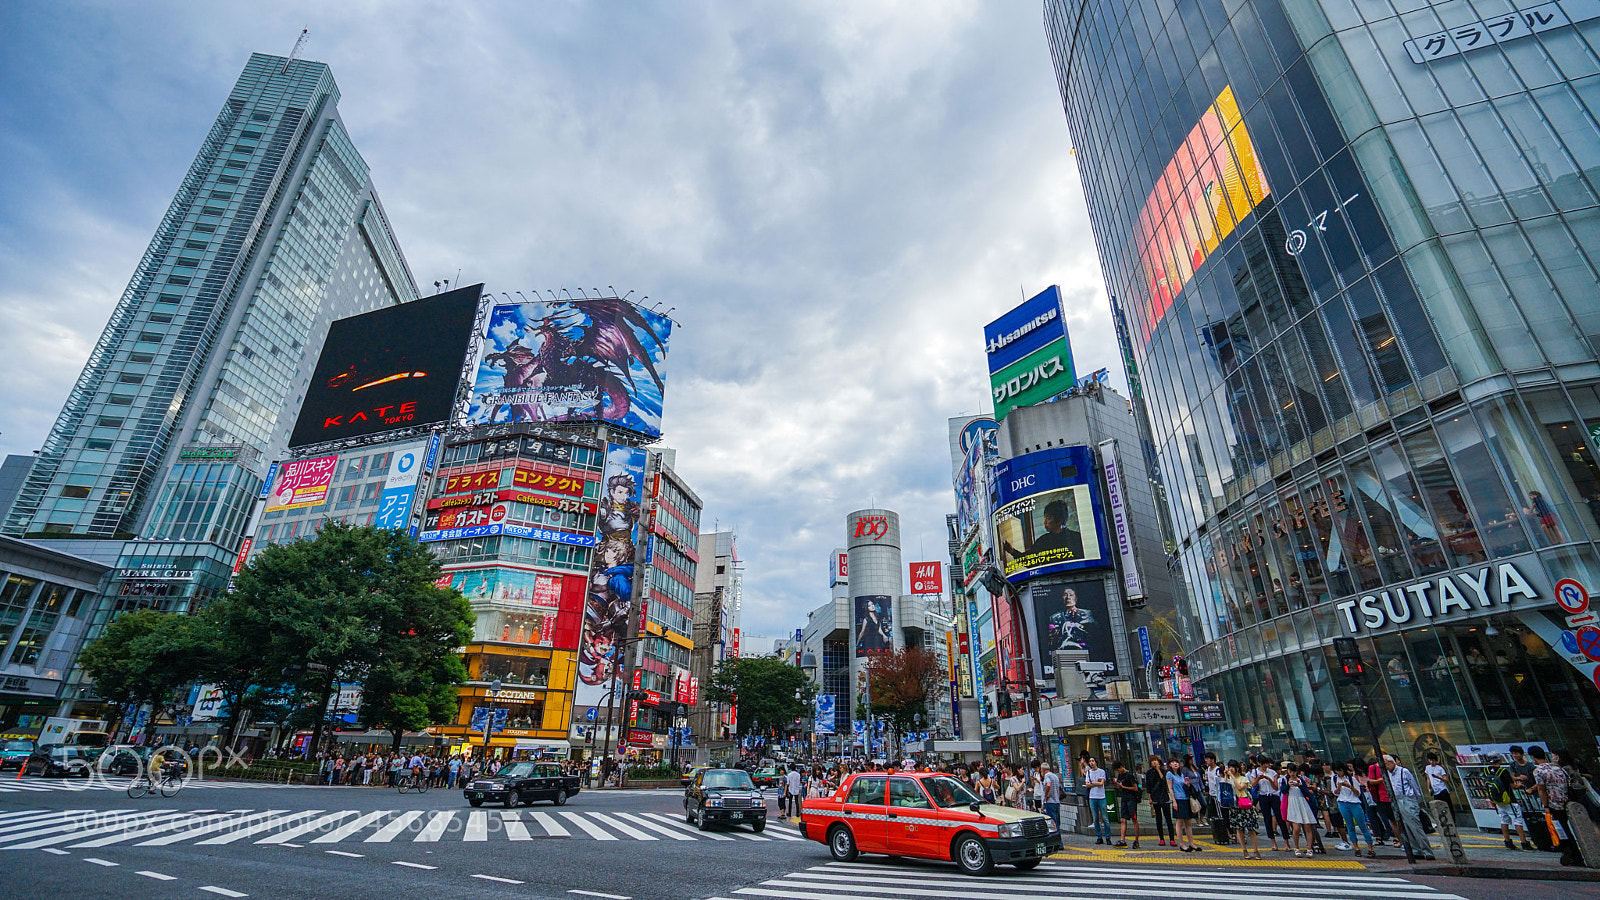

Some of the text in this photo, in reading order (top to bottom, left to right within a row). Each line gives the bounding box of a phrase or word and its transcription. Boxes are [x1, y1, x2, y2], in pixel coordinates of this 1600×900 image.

[1424, 10, 1556, 56] グラブル
[985, 307, 1057, 354] Hisamitsu
[993, 355, 1065, 403] サロンパス
[484, 385, 599, 405] GRANBLUE FANTASY
[323, 400, 418, 429] KATE
[384, 413, 414, 424] TOKYO
[284, 459, 336, 478] 品川スキン
[282, 471, 332, 490] クリニック
[448, 471, 498, 490] プライス
[514, 470, 583, 492] コンタクト
[1011, 474, 1036, 492] DHC
[472, 491, 499, 506] ガスト
[558, 499, 591, 514] ガスト
[1105, 459, 1129, 556] Taisei neon
[426, 516, 439, 527] 7F
[454, 511, 488, 528] ガスト
[533, 530, 594, 545] 英会話イーオン
[853, 520, 888, 541] 109
[119, 569, 196, 578] MARK CITY
[915, 565, 935, 579] H&M
[1337, 562, 1538, 633] TSUTAYA
